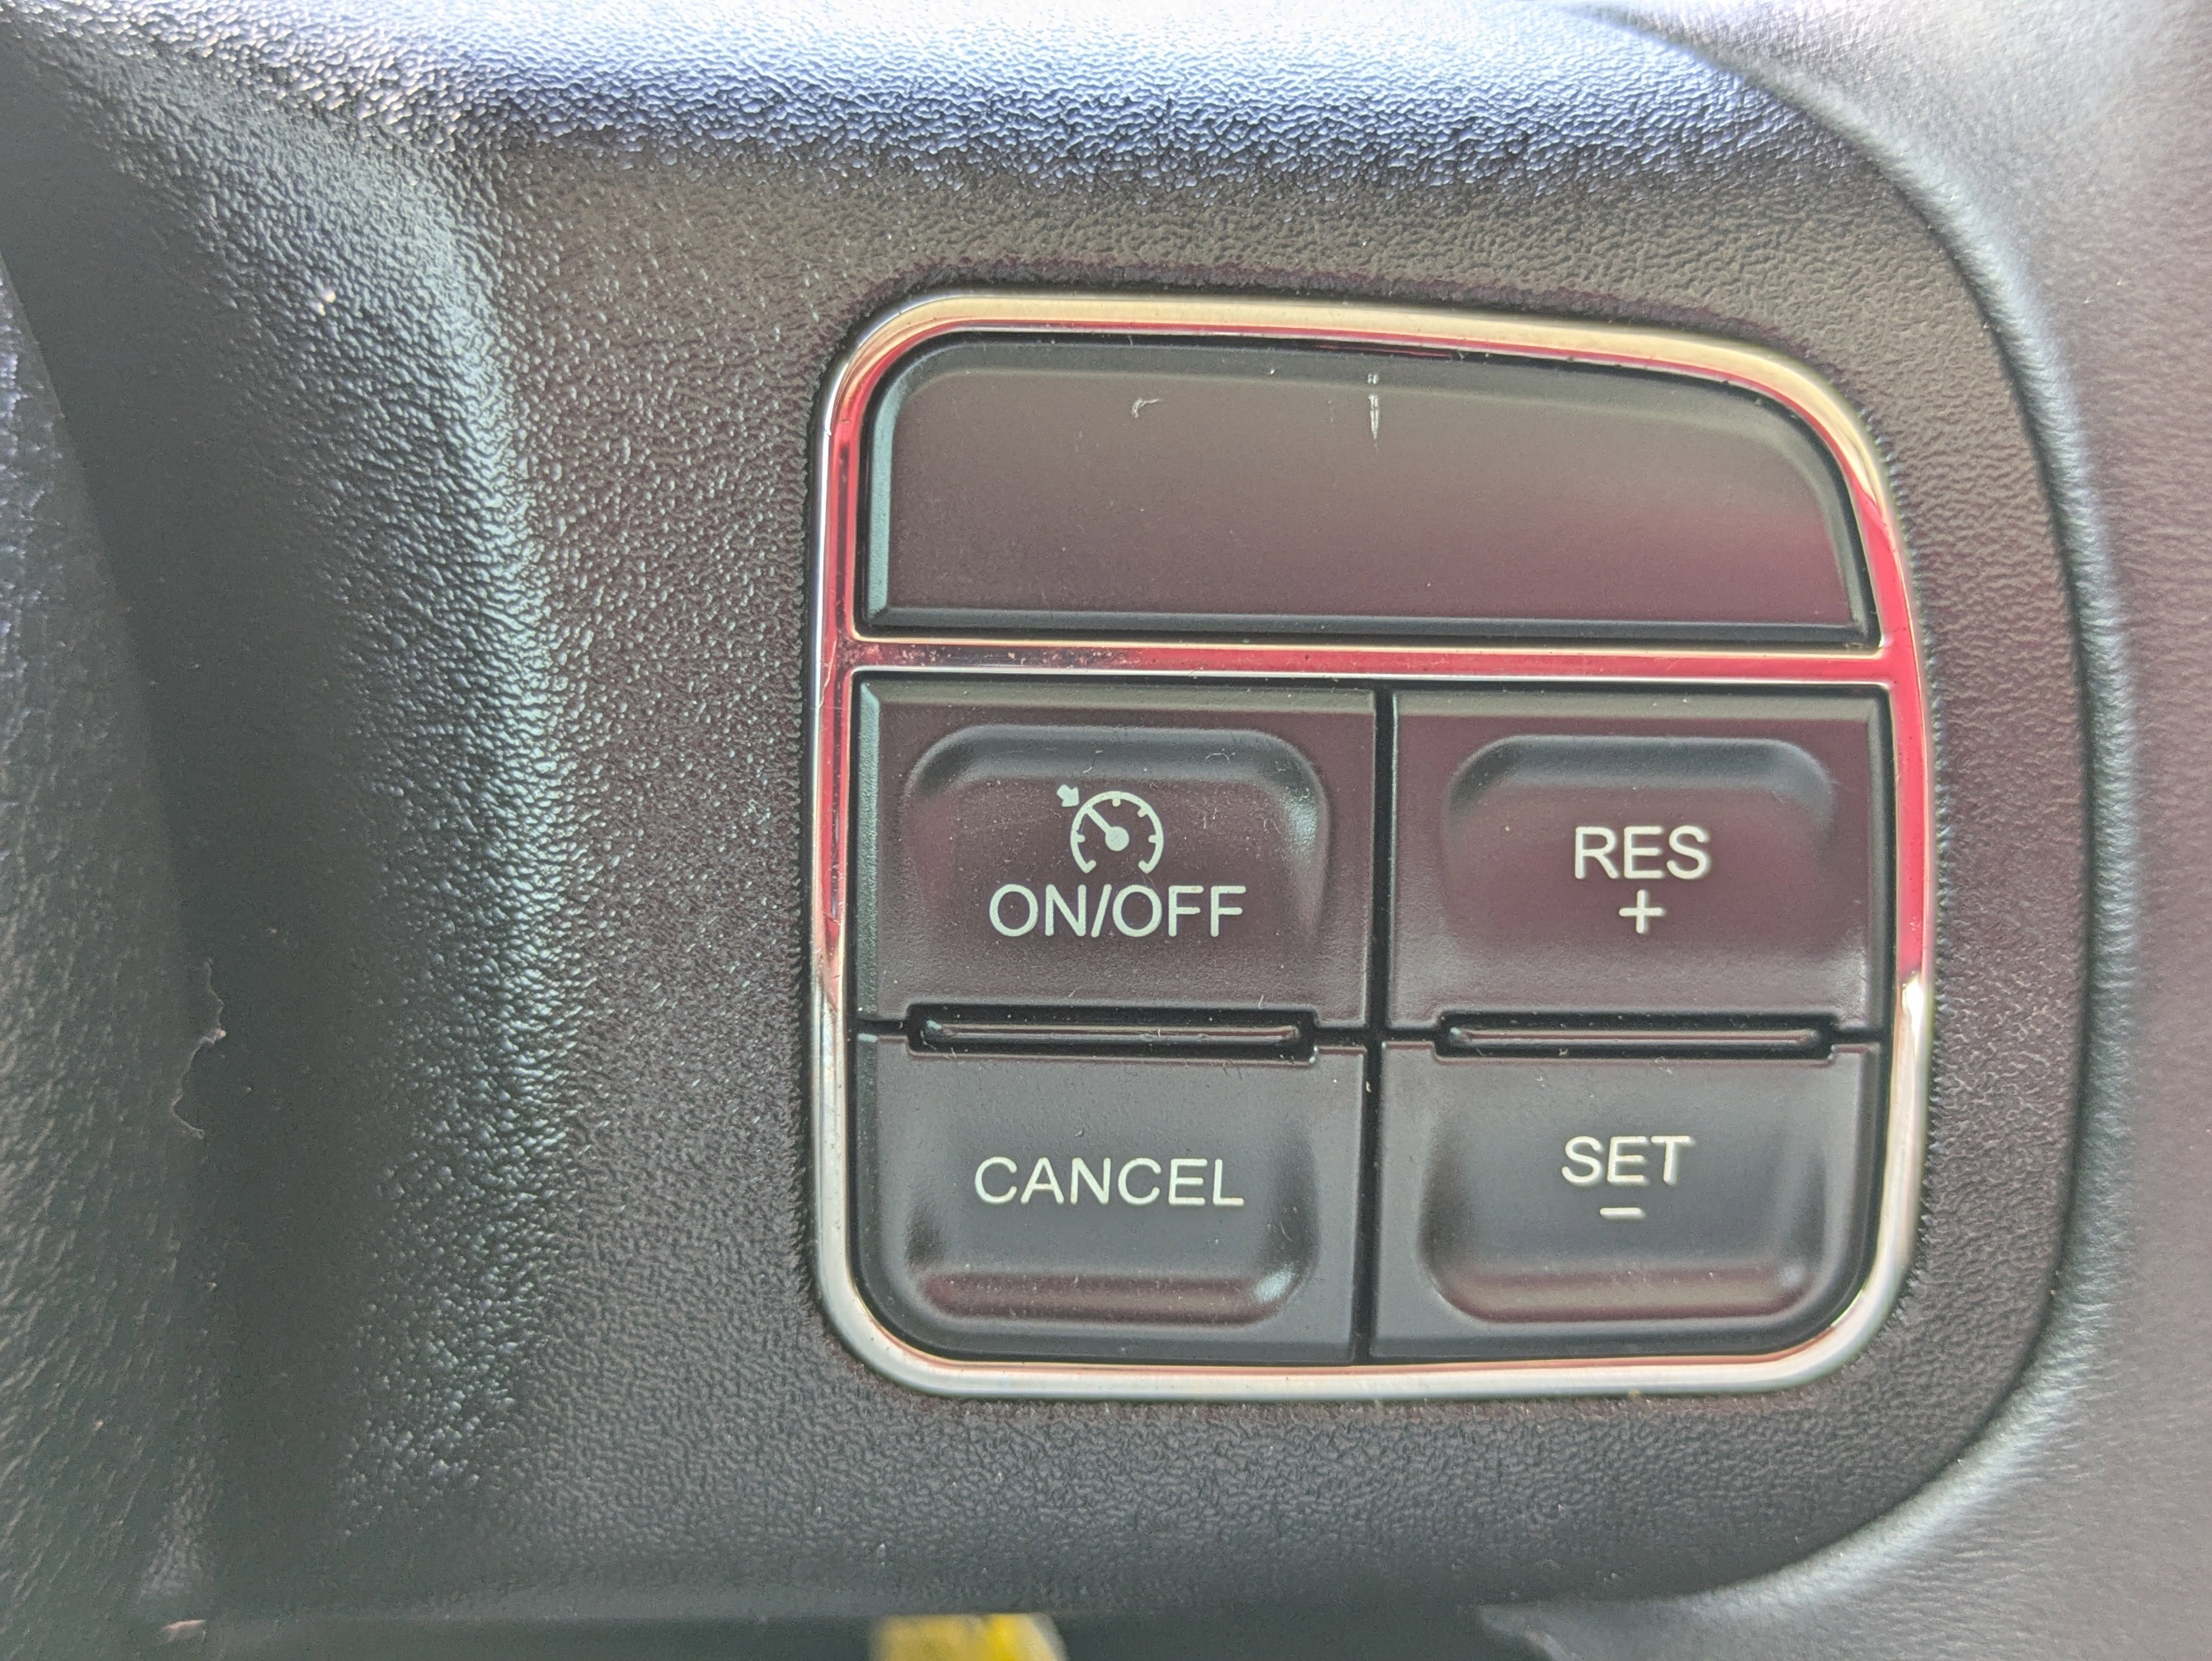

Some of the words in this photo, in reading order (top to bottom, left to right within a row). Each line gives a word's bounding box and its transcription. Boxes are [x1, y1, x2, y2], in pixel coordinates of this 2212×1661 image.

[1574, 825, 1710, 879] RES
[989, 884, 1247, 938] ON/OFF
[974, 1156, 1245, 1206] CANCEL
[1561, 1135, 1694, 1185] SET
